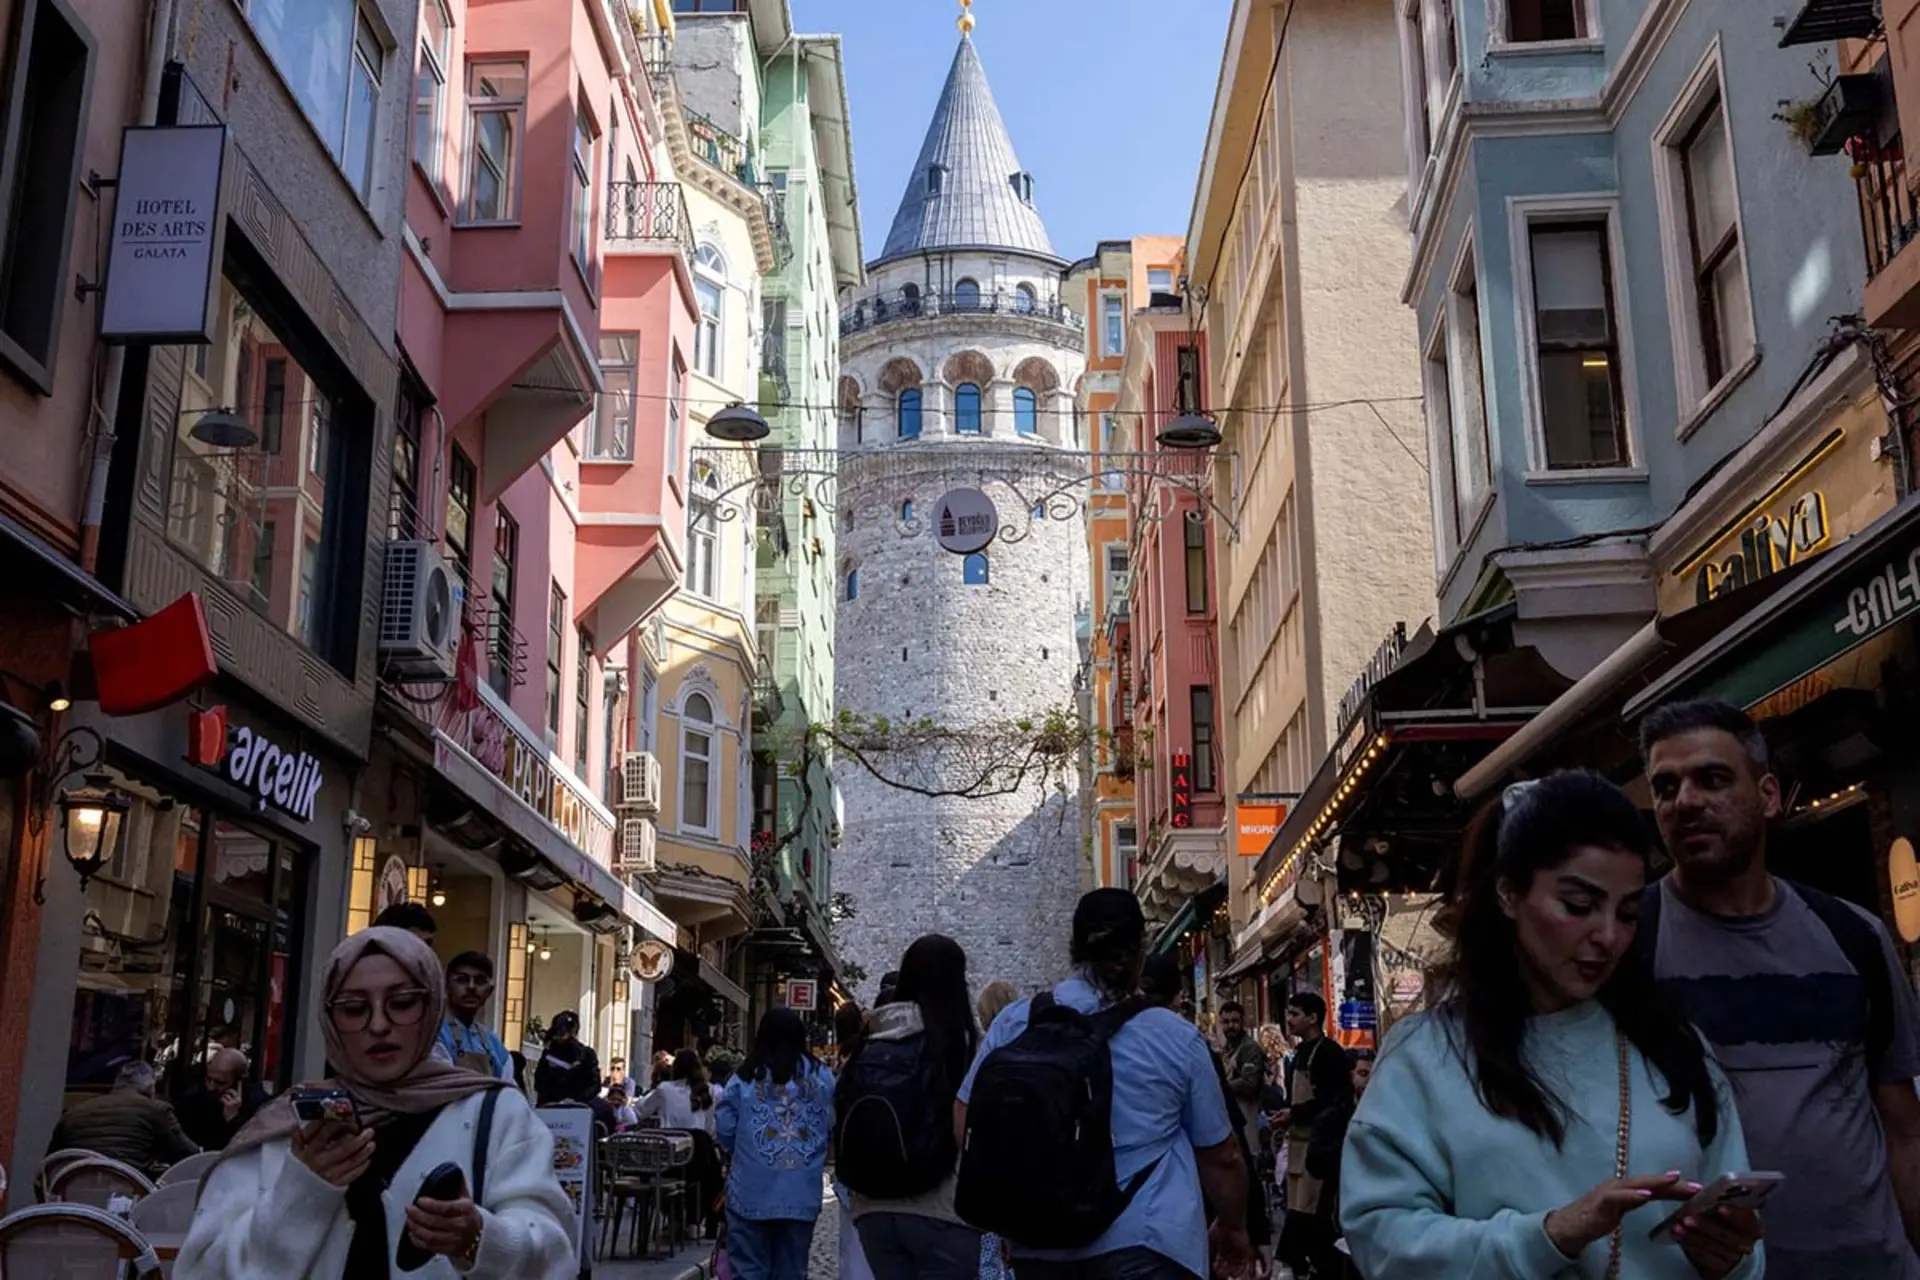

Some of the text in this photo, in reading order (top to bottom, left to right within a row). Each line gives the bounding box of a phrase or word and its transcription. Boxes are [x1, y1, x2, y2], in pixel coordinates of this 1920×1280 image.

[136, 199, 196, 215] HOTEL
[121, 220, 206, 238] DES ARTS
[134, 247, 187, 259] GALATA
[229, 726, 323, 822] arçelik
[1241, 824, 1278, 834] MIGRO
